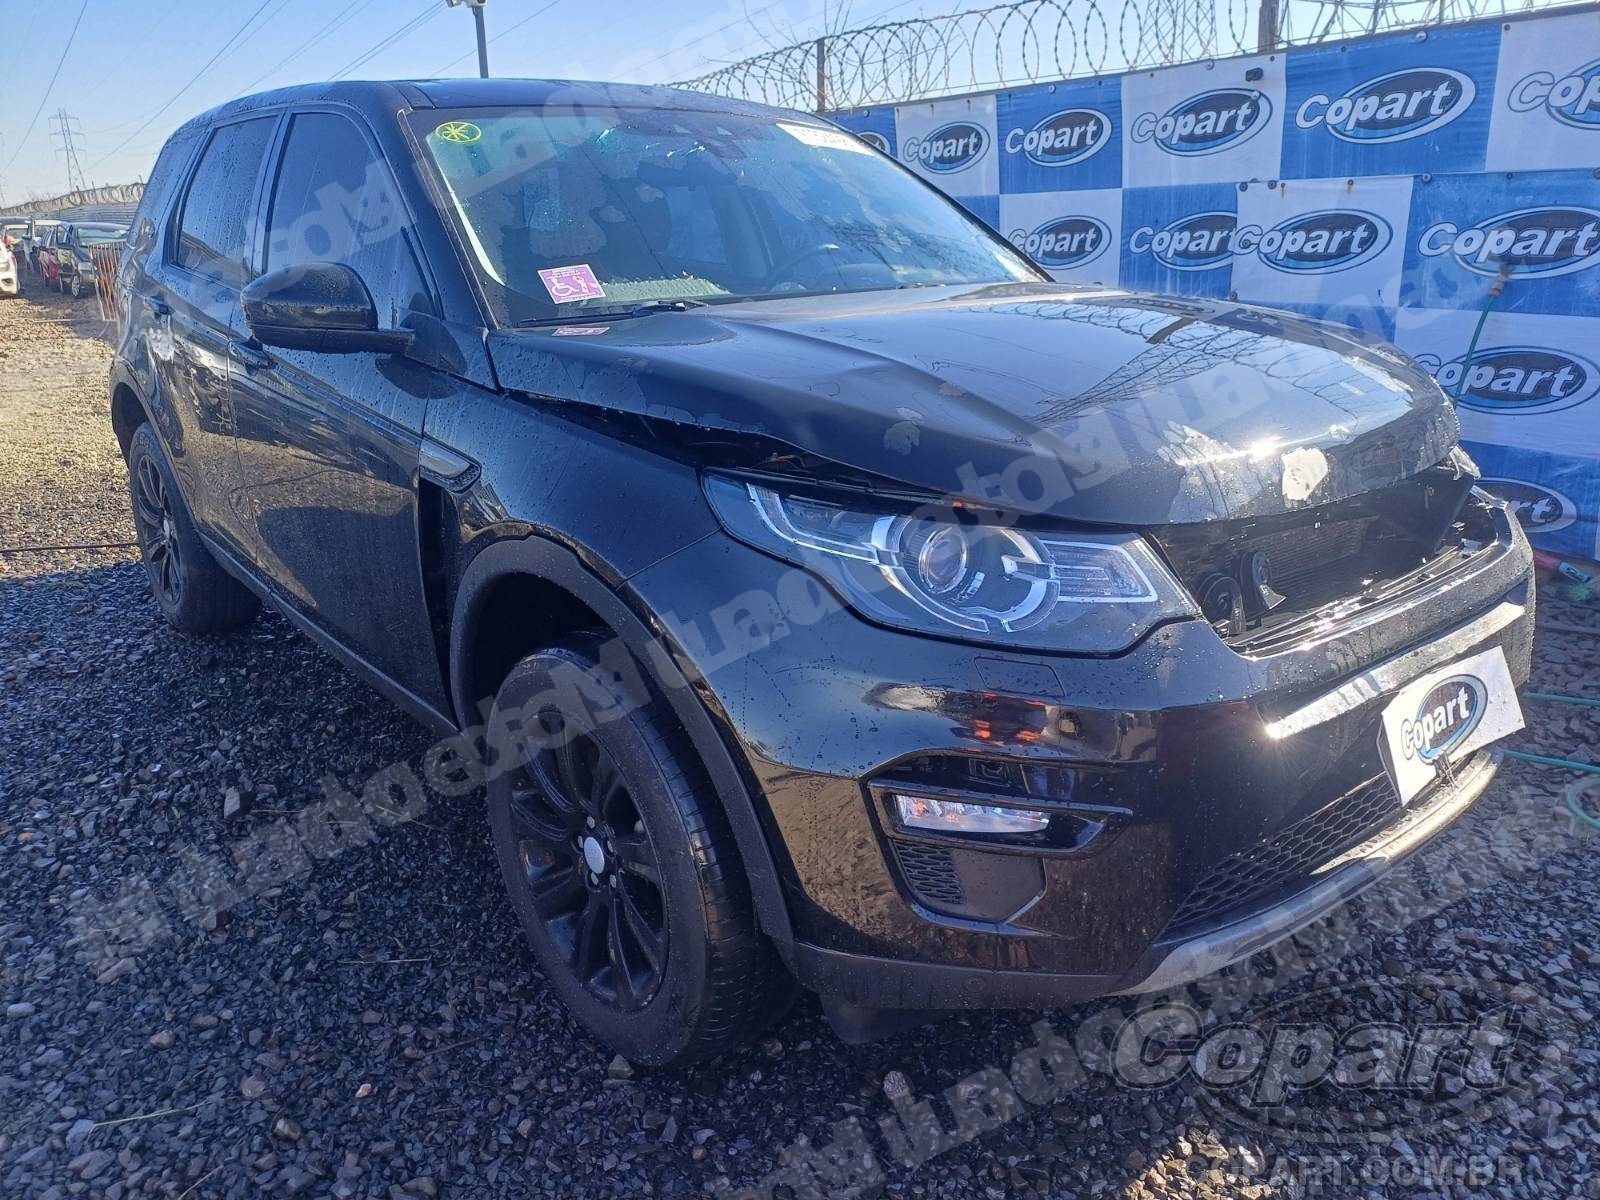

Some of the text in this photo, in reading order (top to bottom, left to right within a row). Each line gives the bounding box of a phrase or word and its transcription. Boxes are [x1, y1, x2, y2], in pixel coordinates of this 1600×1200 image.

[1131, 101, 1252, 144] Copart
[1295, 77, 1452, 131] Copart
[903, 132, 980, 163] Copart
[1003, 117, 1099, 156] Copart
[1231, 222, 1371, 261] Copart
[1418, 215, 1600, 263] Copart
[1401, 687, 1470, 760] Copart
